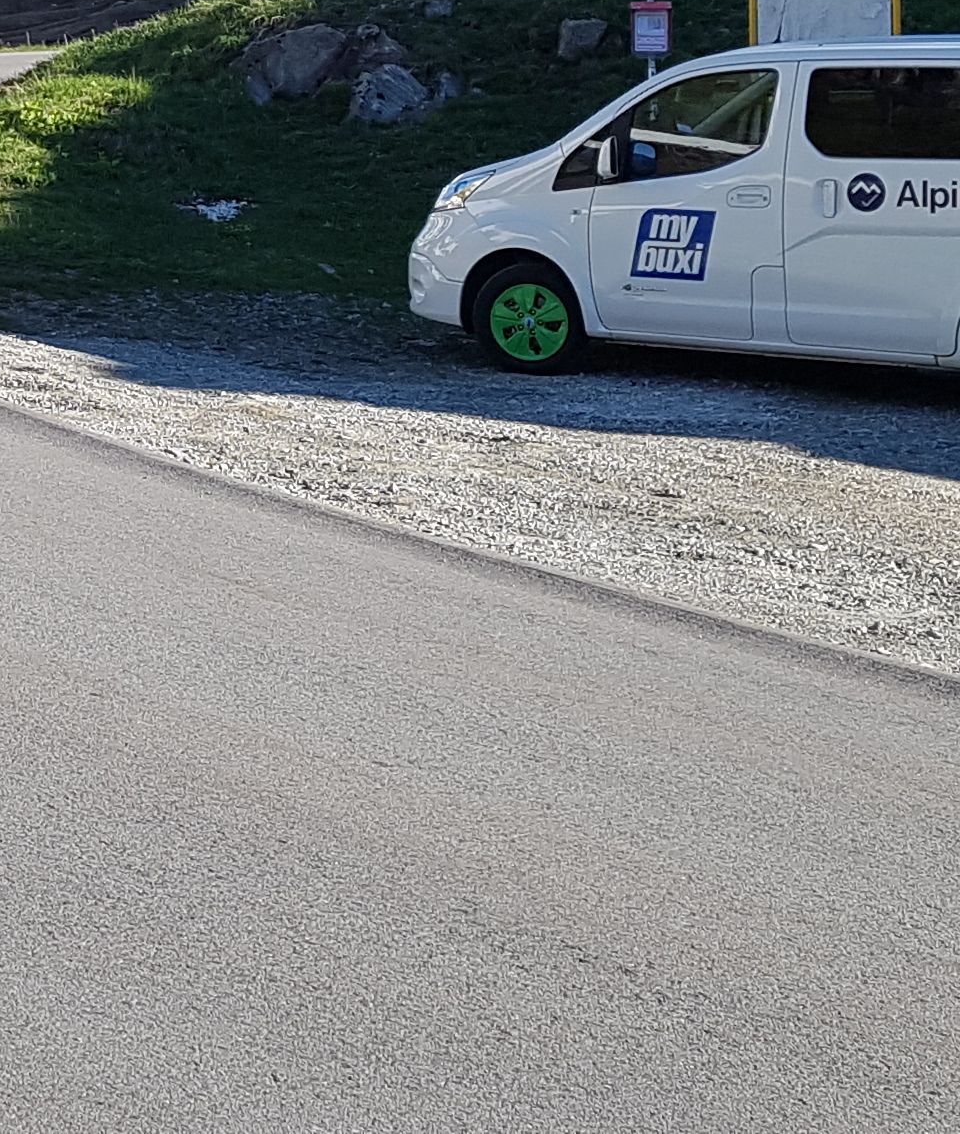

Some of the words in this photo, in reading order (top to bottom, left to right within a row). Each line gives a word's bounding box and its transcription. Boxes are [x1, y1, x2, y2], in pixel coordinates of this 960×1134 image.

[897, 180, 958, 214] Alpi
[648, 214, 699, 248] my
[637, 241, 704, 275] buxi
